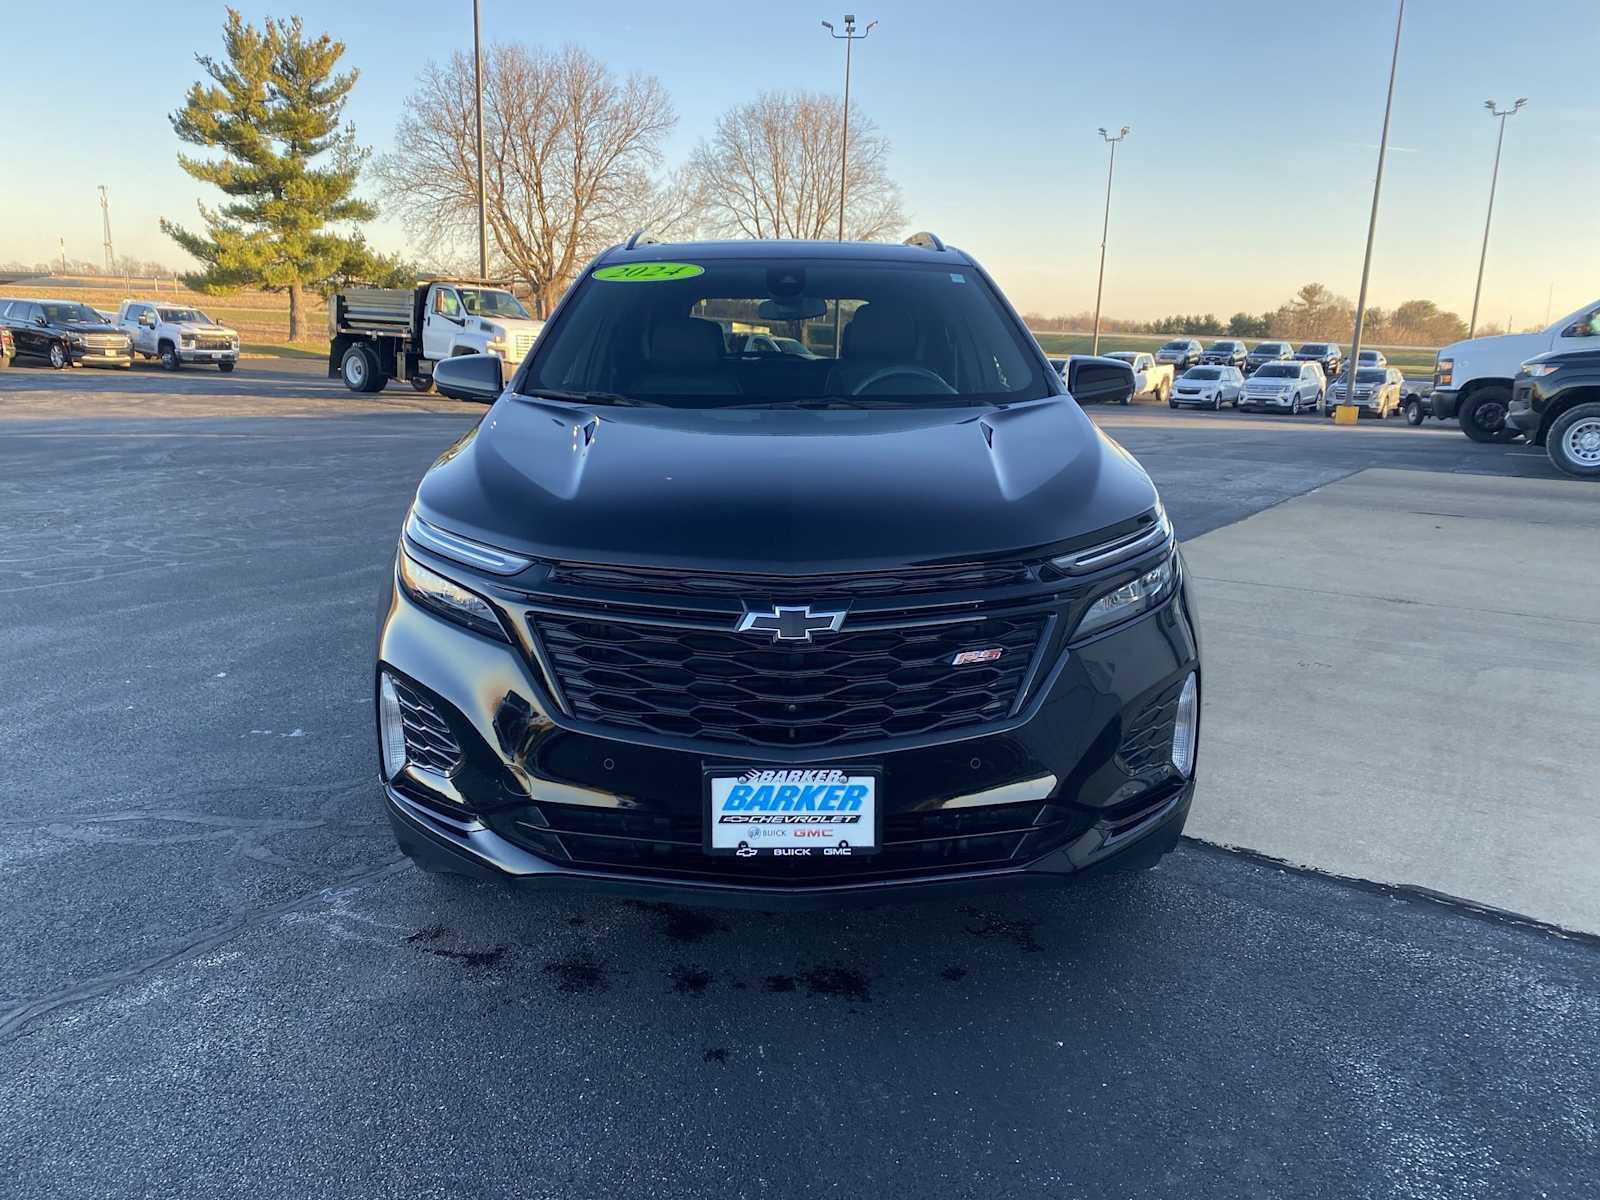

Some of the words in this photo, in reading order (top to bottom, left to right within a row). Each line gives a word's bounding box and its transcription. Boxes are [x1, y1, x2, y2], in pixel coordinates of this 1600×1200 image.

[607, 266, 689, 278] 2024
[952, 648, 1003, 665] RS
[759, 769, 842, 783] BARKER
[722, 784, 868, 811] BARKER
[748, 815, 857, 823] CHEVROLET
[762, 828, 786, 837] BUICK
[794, 829, 833, 837] GMC
[773, 848, 812, 856] BUICK
[823, 848, 852, 856] GMC
